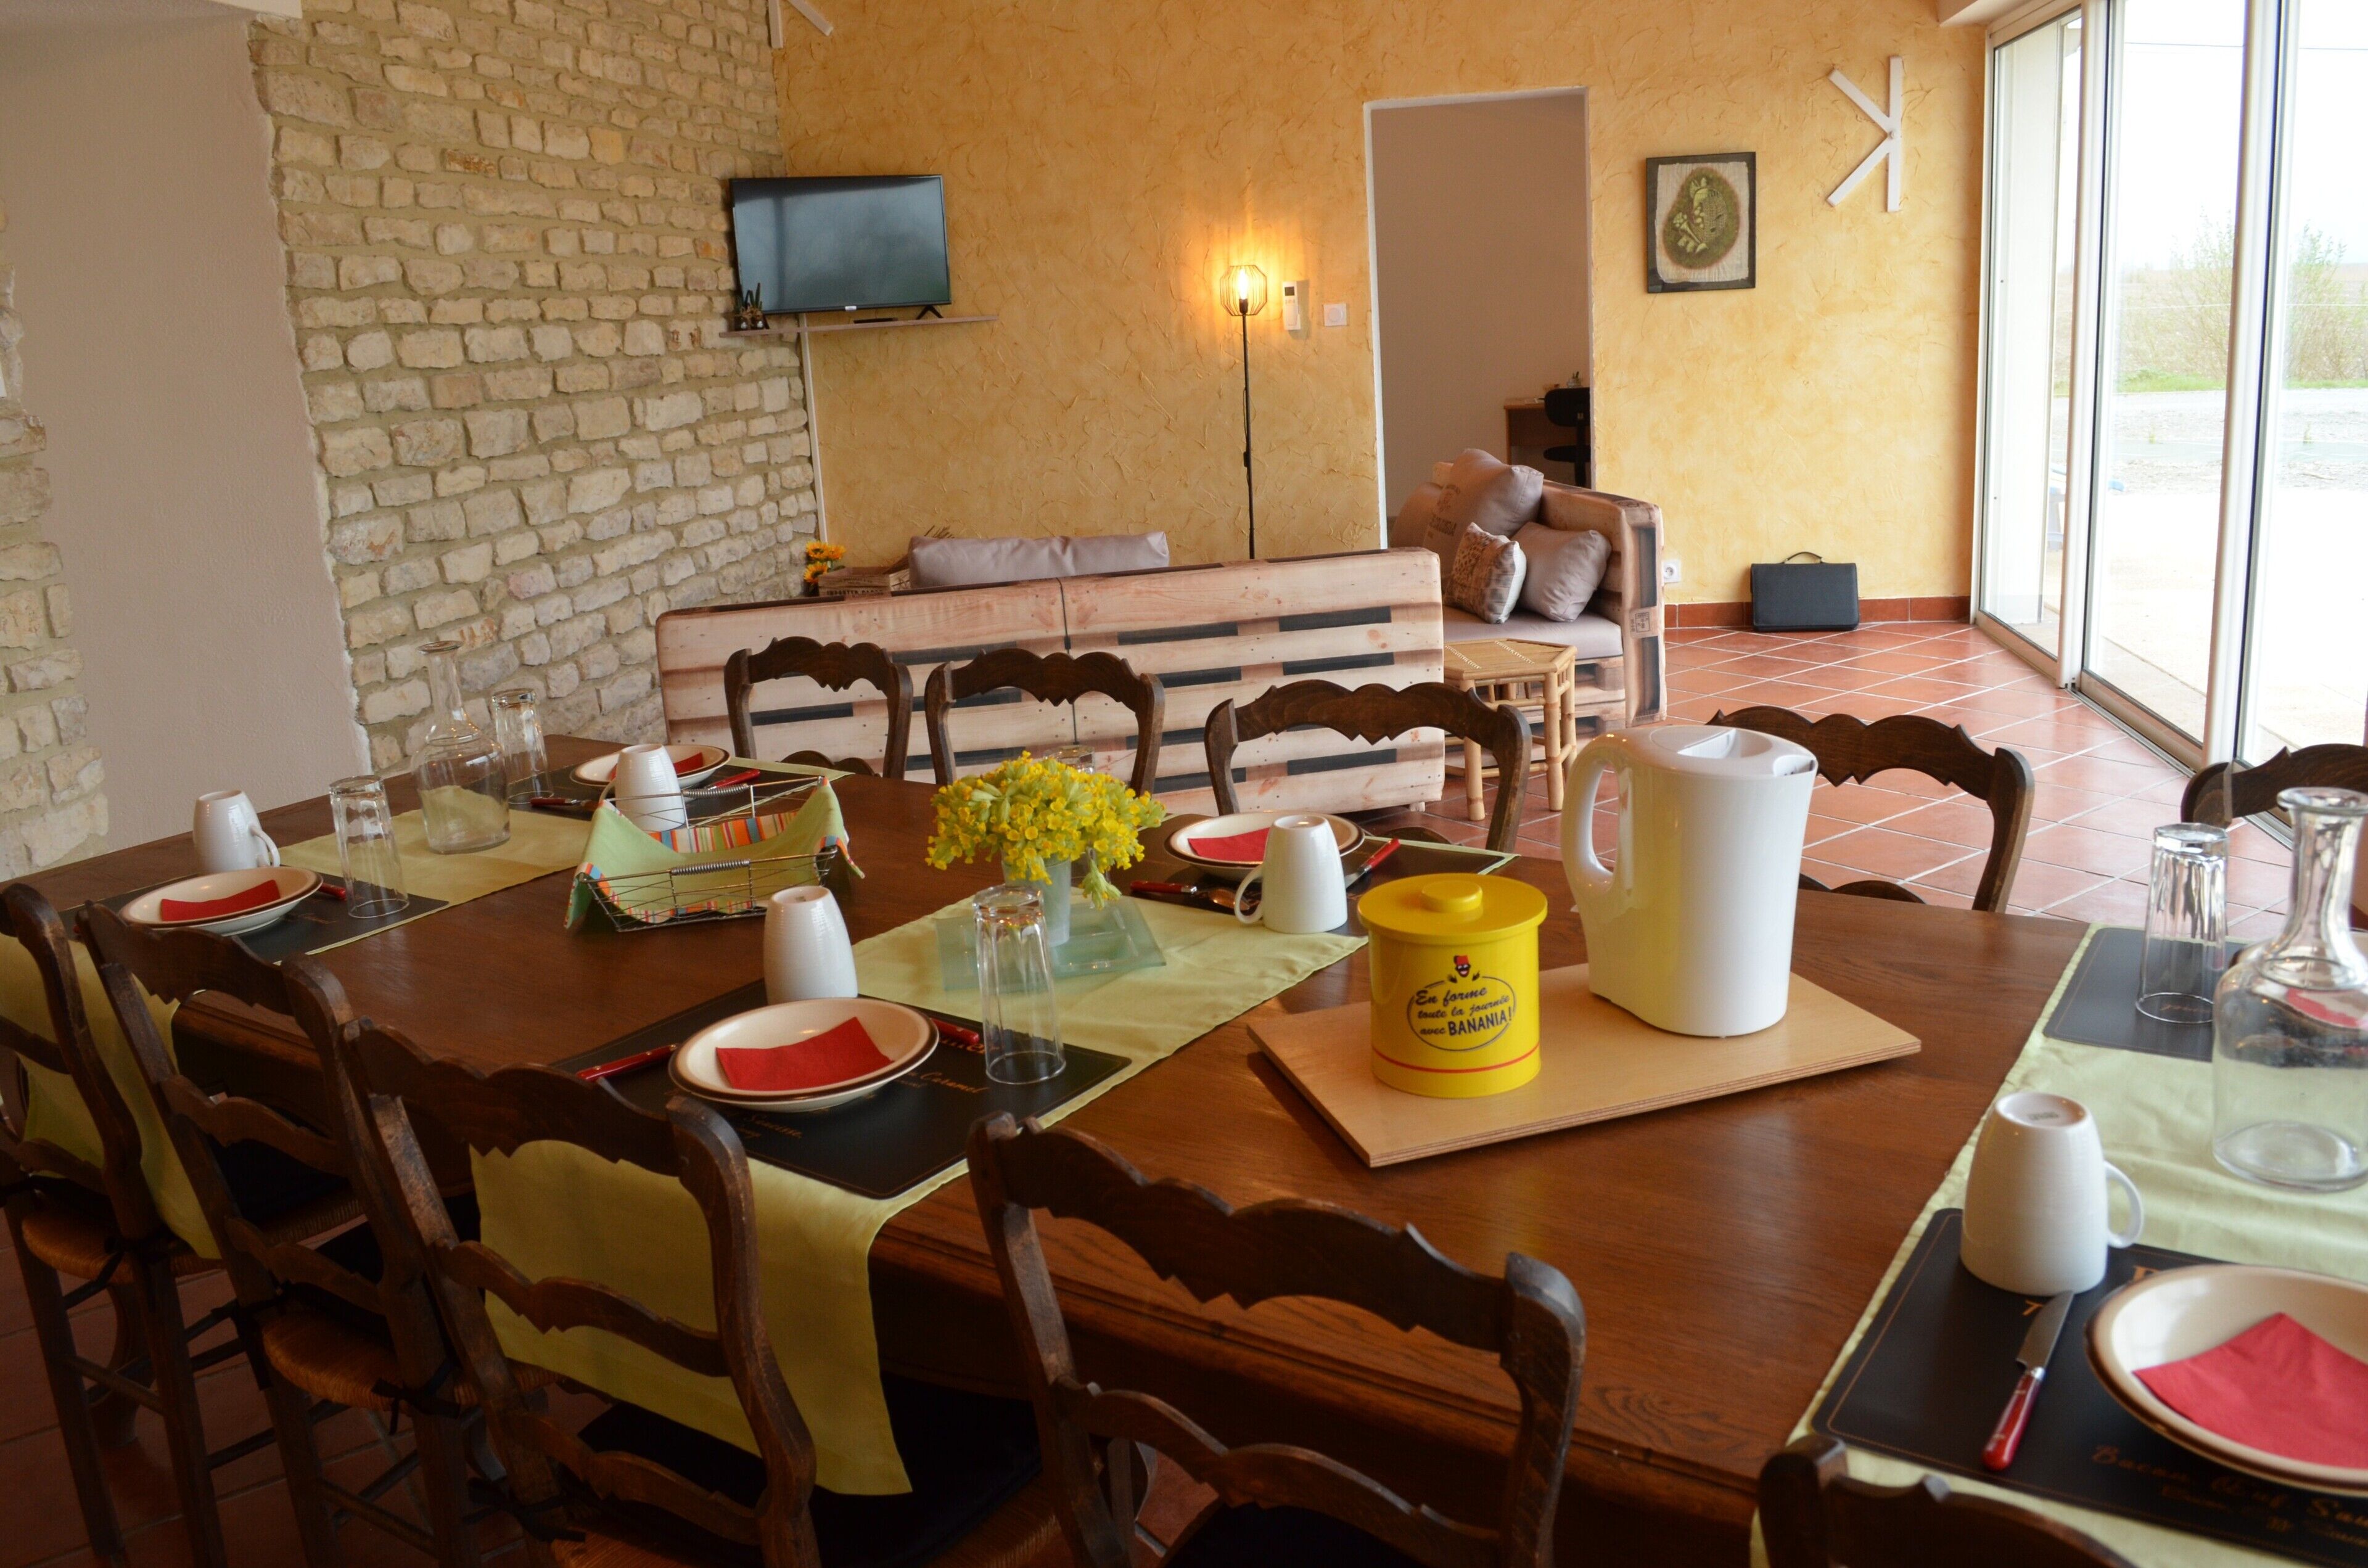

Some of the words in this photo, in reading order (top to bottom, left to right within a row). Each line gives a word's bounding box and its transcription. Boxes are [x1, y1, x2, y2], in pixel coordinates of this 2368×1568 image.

[1416, 990, 1437, 1006] En
[1443, 987, 1487, 1007] forme
[1418, 1009, 1447, 1019] toute
[1452, 1006, 1464, 1016] la
[1420, 1027, 1445, 1035] avec
